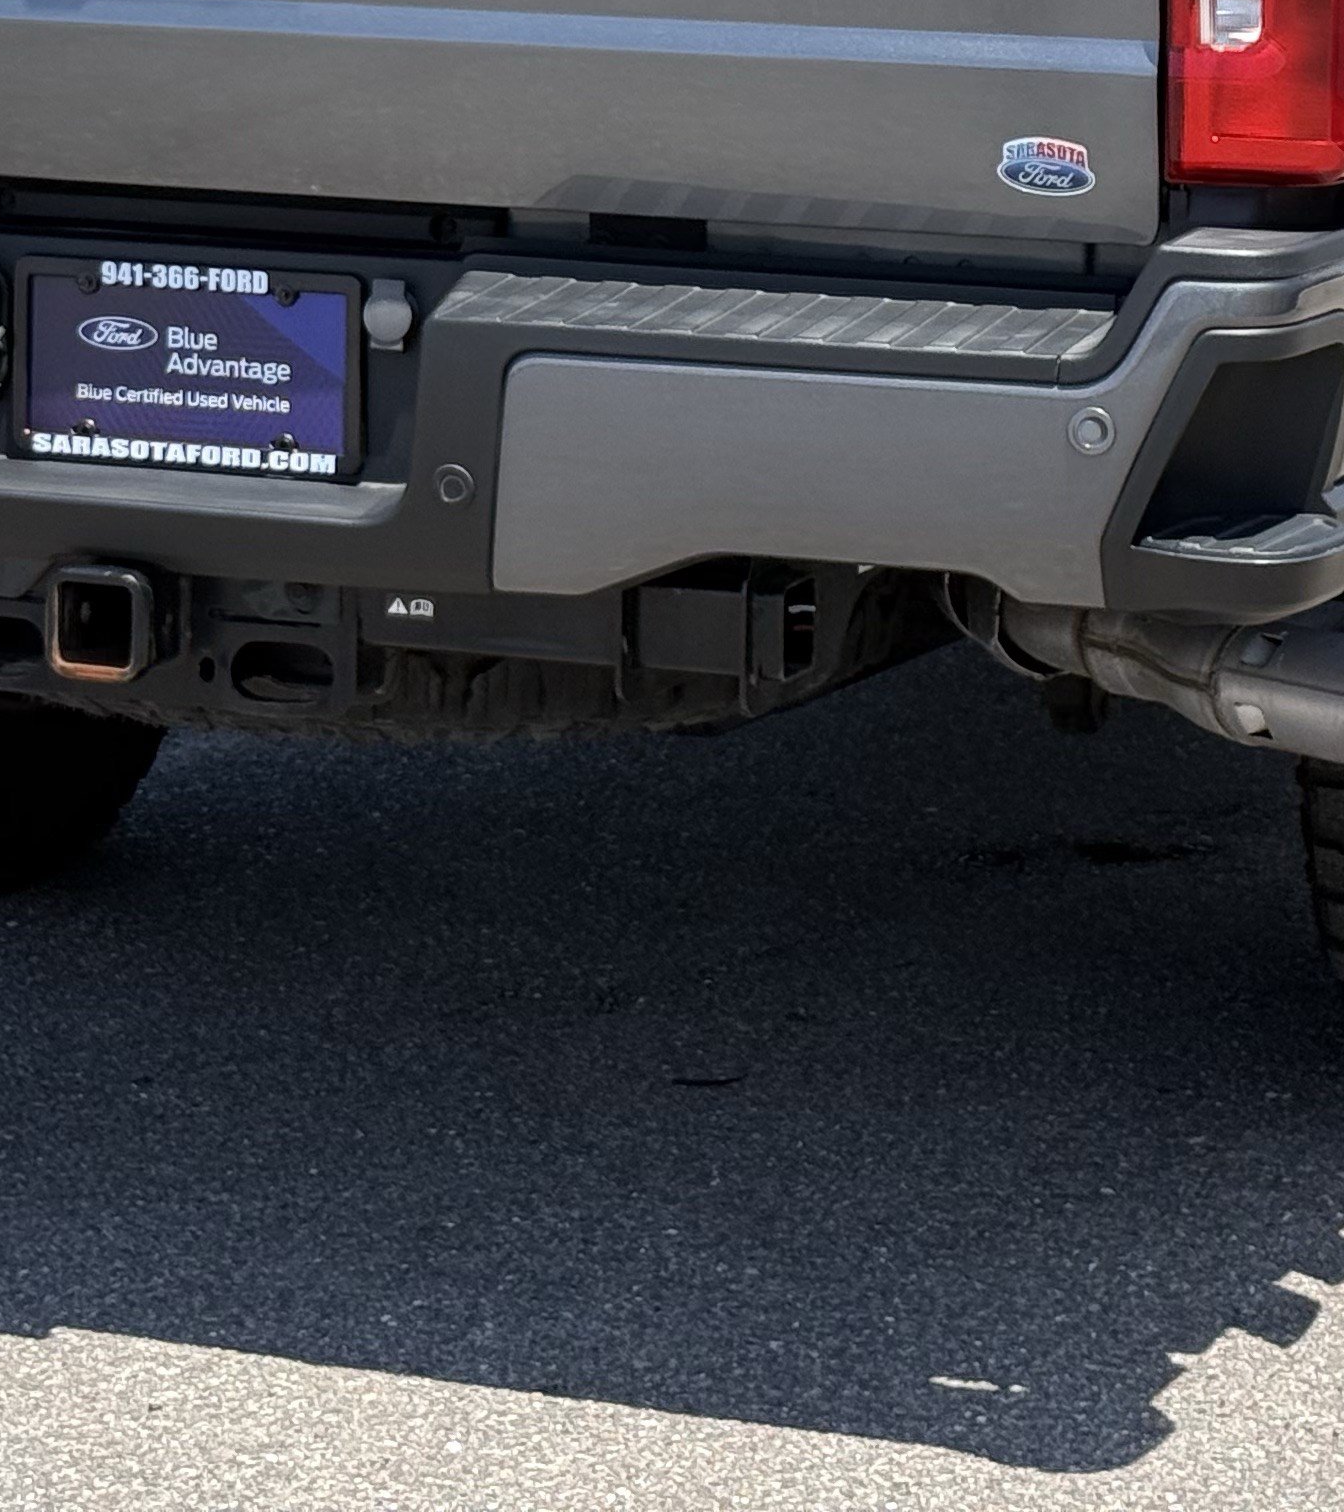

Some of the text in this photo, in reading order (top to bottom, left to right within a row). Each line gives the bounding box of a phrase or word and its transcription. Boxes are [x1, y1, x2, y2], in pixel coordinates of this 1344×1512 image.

[1006, 141, 1085, 168] SARASOTA
[1018, 162, 1074, 189] Ford
[101, 260, 270, 295] 941-366-FORD
[92, 321, 143, 347] Ford
[166, 326, 218, 352] Blue
[166, 352, 292, 384] Advantage
[76, 383, 291, 414] Blue Certified Used Vehicle
[31, 432, 337, 475] SARASOTAFORD.COM
